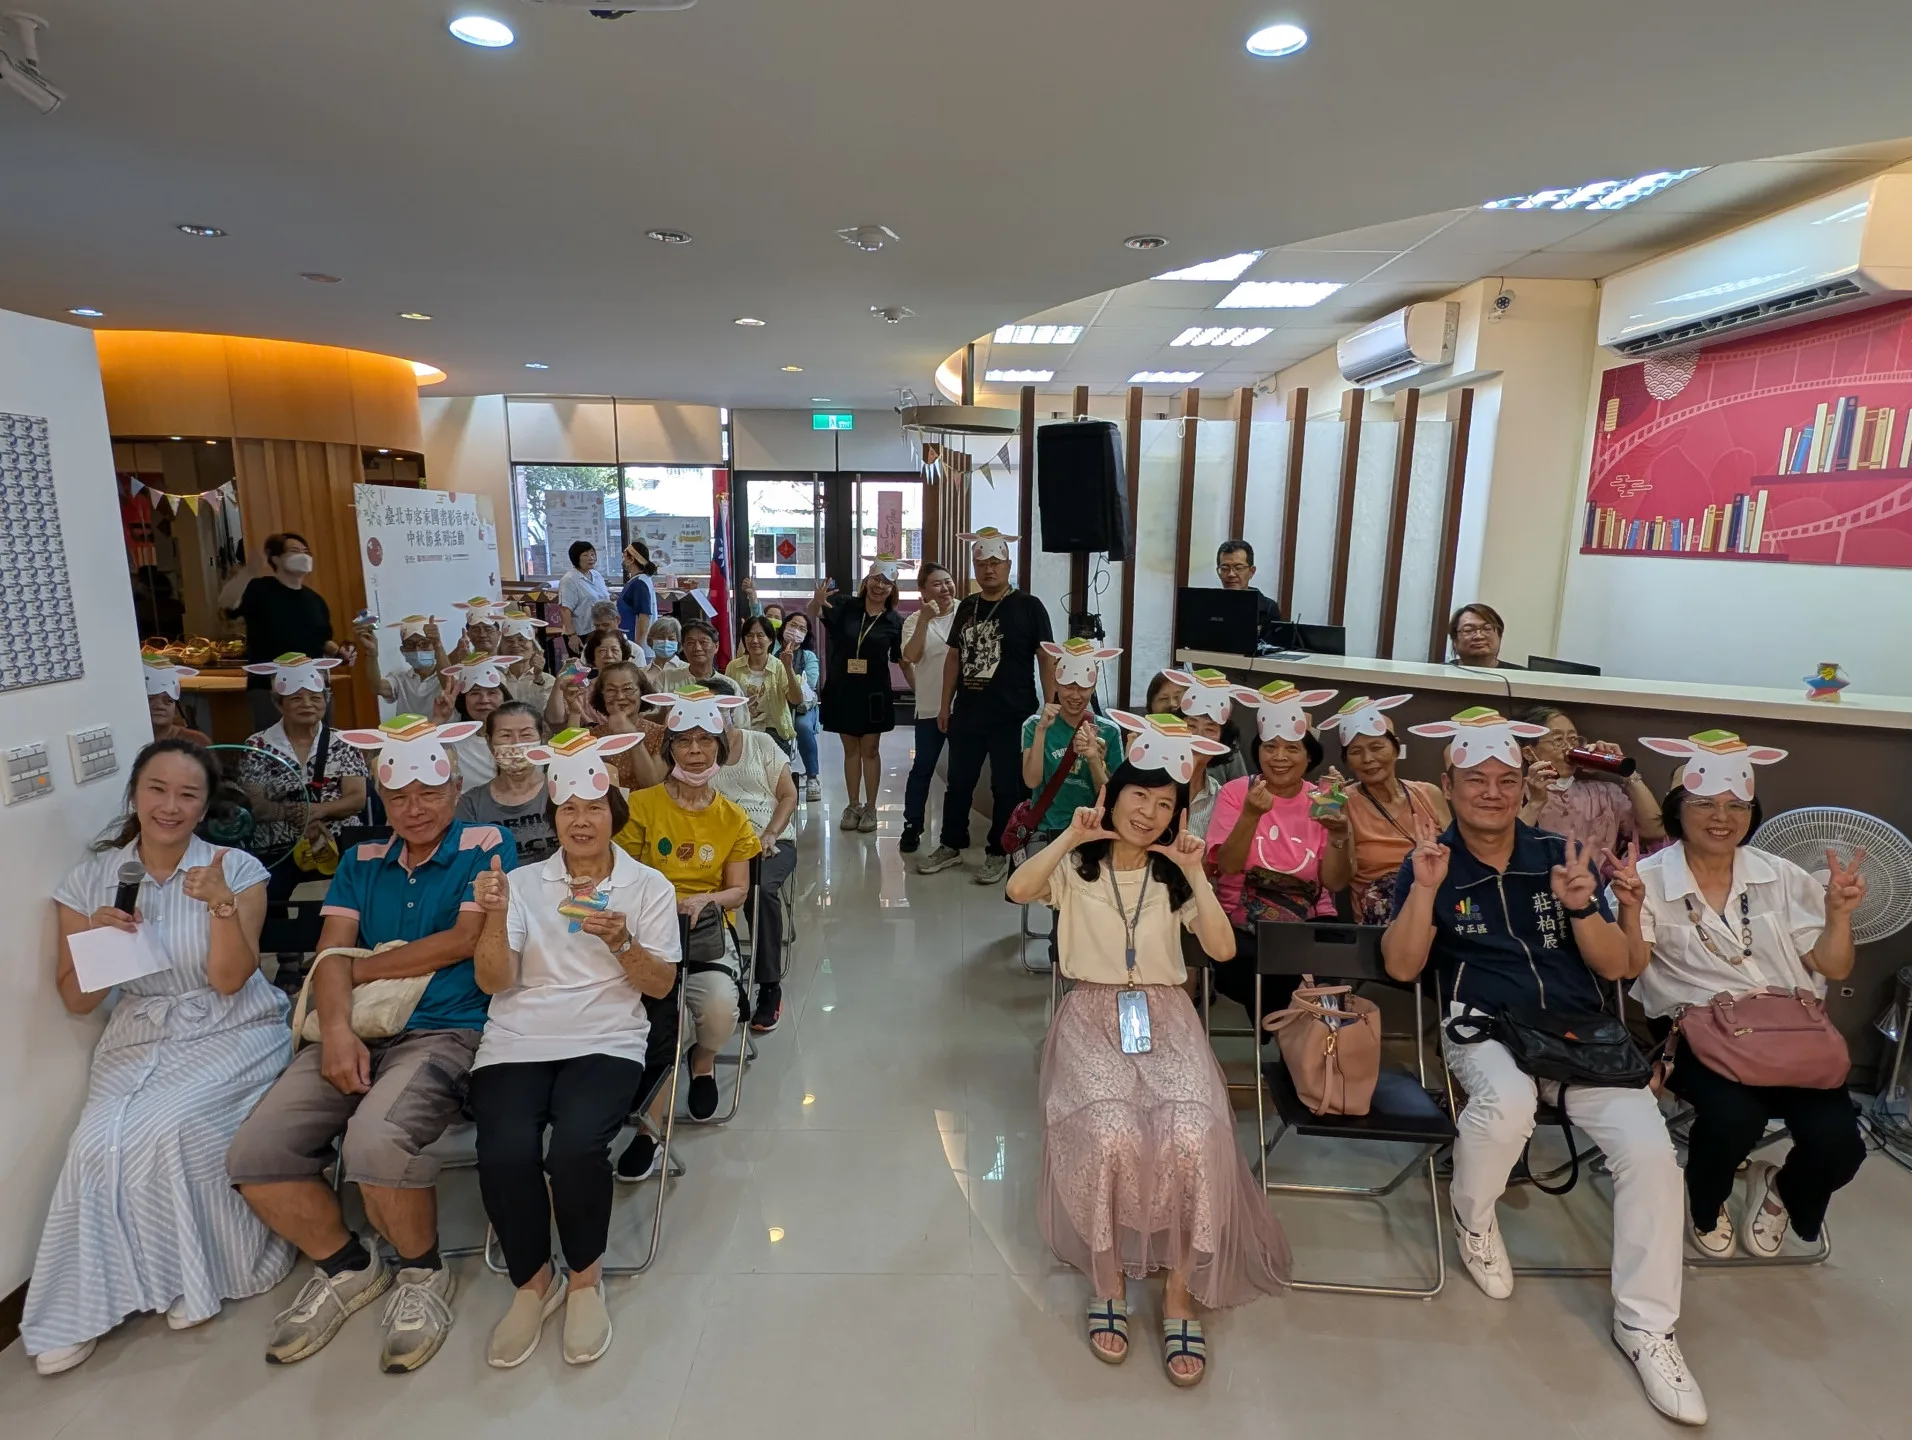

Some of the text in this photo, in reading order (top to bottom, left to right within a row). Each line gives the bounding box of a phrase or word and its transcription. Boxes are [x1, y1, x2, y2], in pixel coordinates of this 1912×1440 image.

[406, 529, 465, 548] 中秋節系列活動
[1454, 923, 1488, 936] 中正區
[1531, 891, 1559, 949] 莊柏辰
